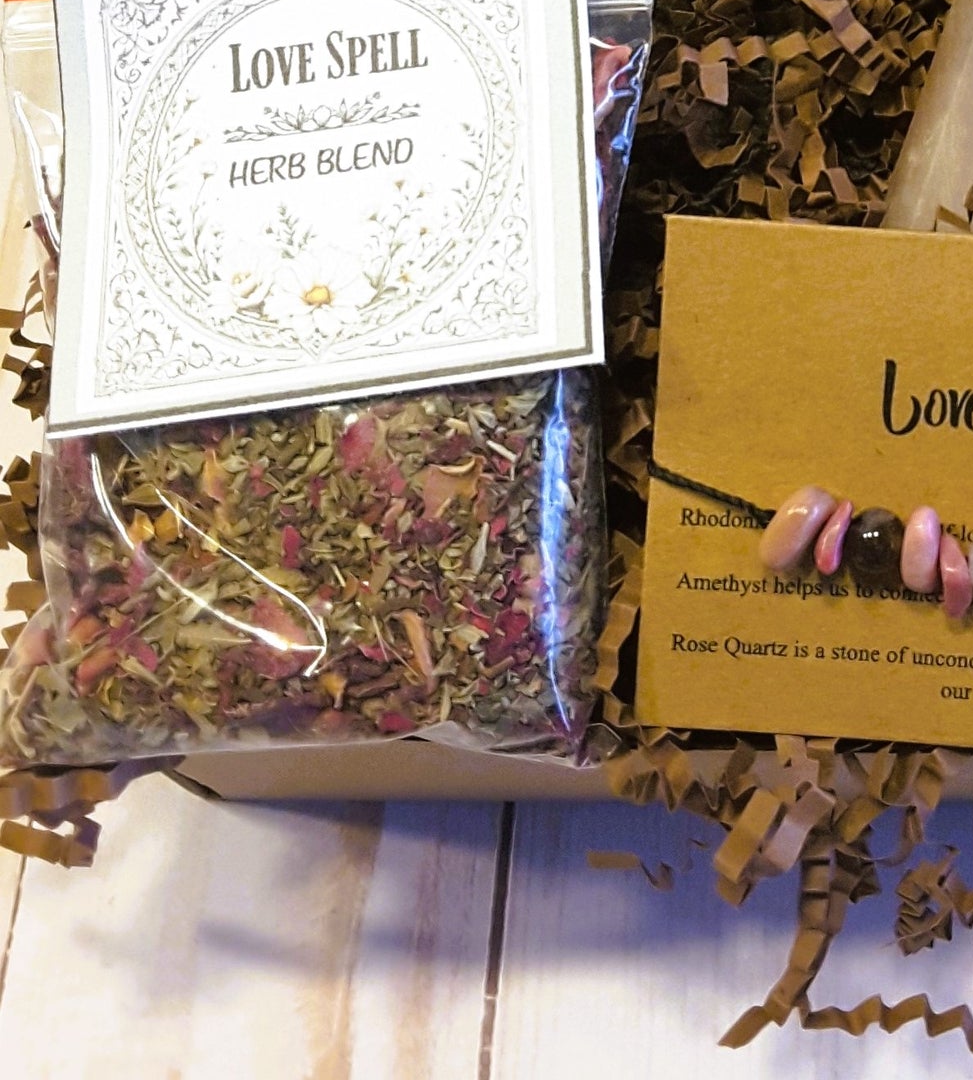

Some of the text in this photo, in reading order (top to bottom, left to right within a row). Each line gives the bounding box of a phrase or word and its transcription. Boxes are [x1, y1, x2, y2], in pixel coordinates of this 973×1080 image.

[227, 137, 415, 188] HERB BLEND
[675, 572, 768, 598] Amethyst
[773, 578, 823, 601] helps
[829, 580, 849, 597] us
[671, 633, 719, 653] Rose
[724, 636, 788, 659] Quartz
[794, 639, 809, 658] is
[815, 645, 826, 659] a
[831, 645, 880, 663] stone
[886, 645, 909, 663] of
[940, 683, 972, 700] our
